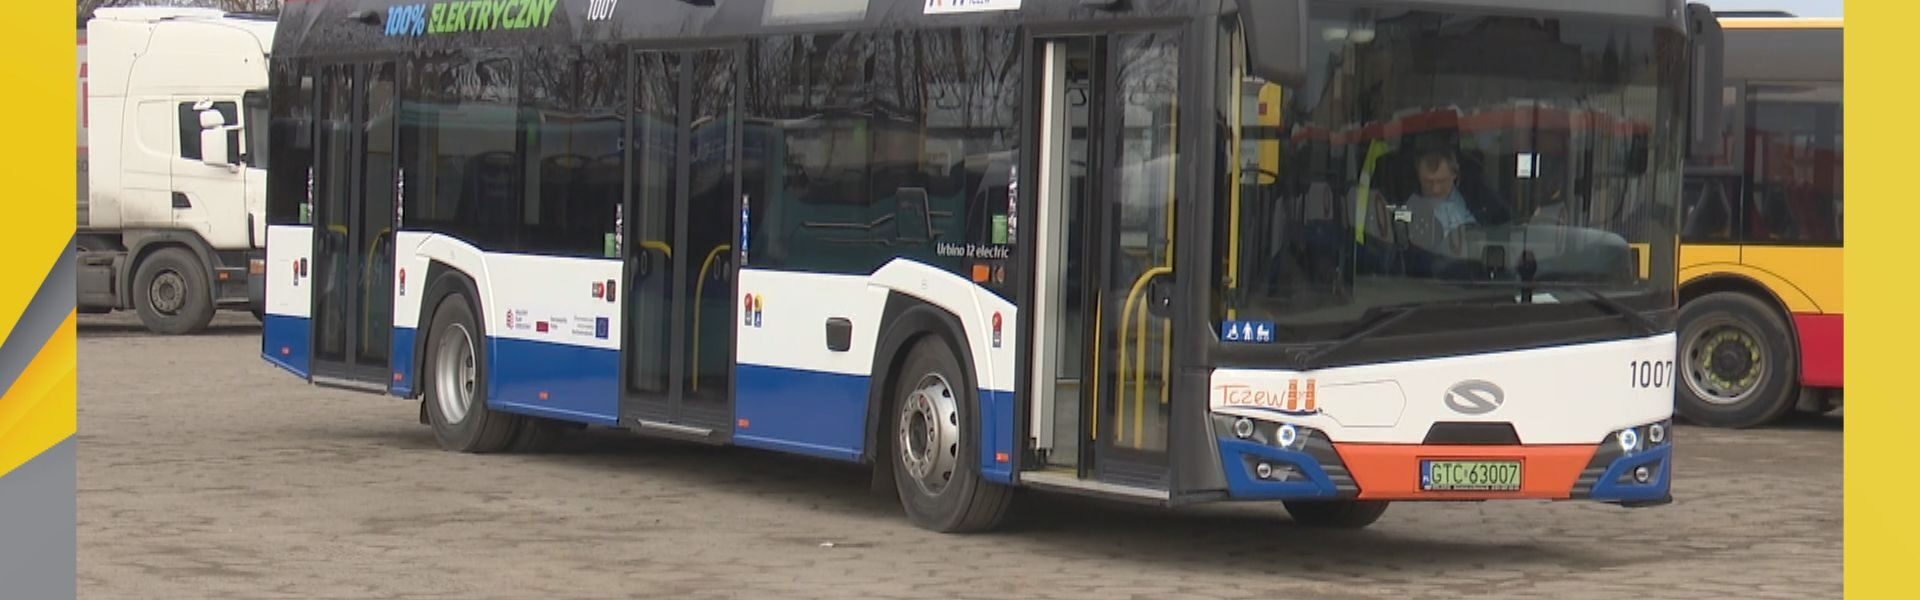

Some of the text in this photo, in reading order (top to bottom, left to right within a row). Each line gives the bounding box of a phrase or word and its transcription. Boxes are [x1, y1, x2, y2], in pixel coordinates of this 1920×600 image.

[384, 0, 557, 37] 100% ELEKTRYCZNY
[586, 0, 617, 21] 1007
[936, 242, 1010, 258] Urbino 12 electric
[1630, 360, 1673, 388] 1007
[1431, 462, 1518, 484] GTC 63007
